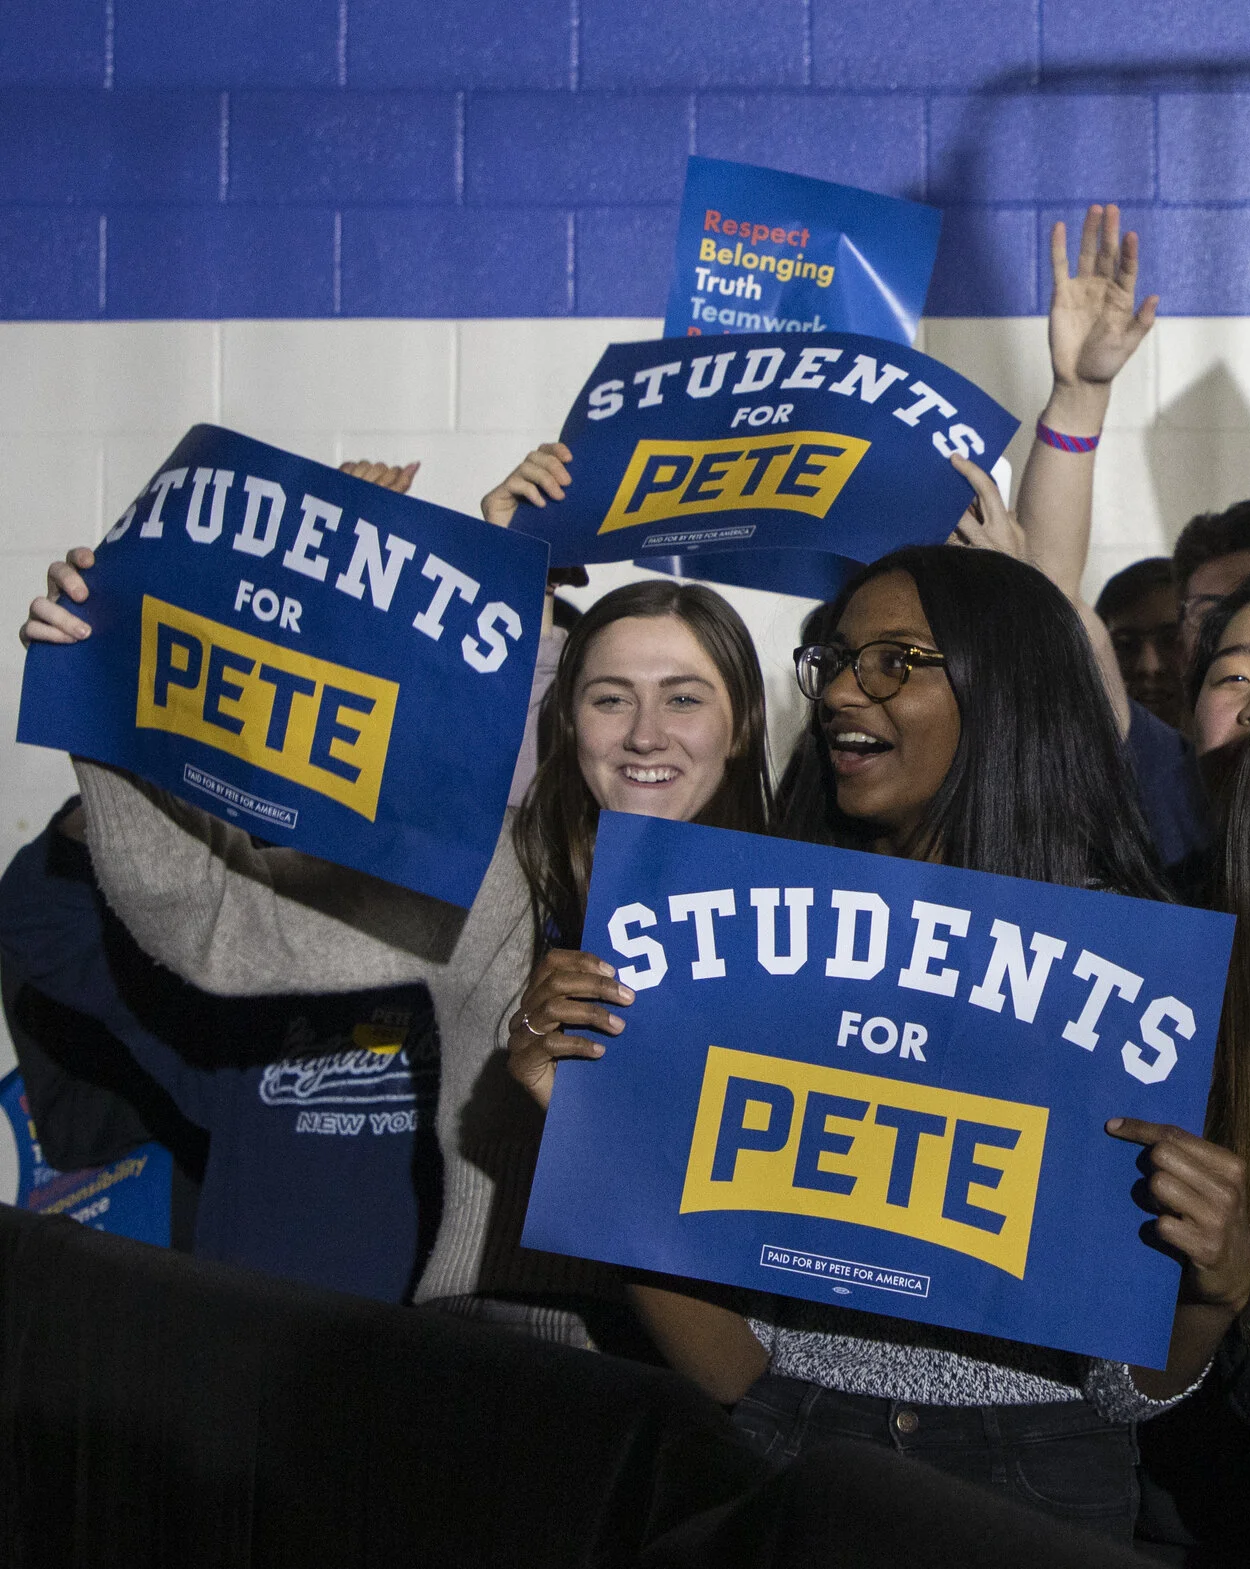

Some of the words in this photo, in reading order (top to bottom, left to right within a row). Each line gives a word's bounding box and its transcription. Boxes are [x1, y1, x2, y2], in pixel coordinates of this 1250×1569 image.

[704, 209, 811, 248] Respect
[695, 266, 762, 301] Truth
[699, 238, 835, 288] Belonging
[691, 296, 828, 333] Teamwork
[587, 347, 985, 460] STUDENTS
[730, 403, 794, 428] FOR
[624, 443, 847, 514] PETE
[234, 580, 302, 633] FOR
[153, 622, 377, 784] PETE
[187, 769, 202, 784] PAID
[202, 777, 216, 791] FOR
[216, 783, 225, 795] BY
[224, 788, 239, 801] PETE
[240, 795, 255, 810] FOR
[254, 801, 292, 823] AMERICA
[607, 887, 1197, 1085] STUDENTS
[836, 1010, 928, 1062] FOR
[296, 1111, 366, 1136] NEW
[369, 1109, 418, 1136] YO
[710, 1075, 1023, 1236] PETE
[767, 1251, 790, 1264] PAID
[792, 1256, 812, 1269] FOR
[815, 1260, 828, 1272] BY
[829, 1263, 851, 1277] PETE
[853, 1268, 874, 1281] FOR
[875, 1273, 923, 1290] AMERICA
